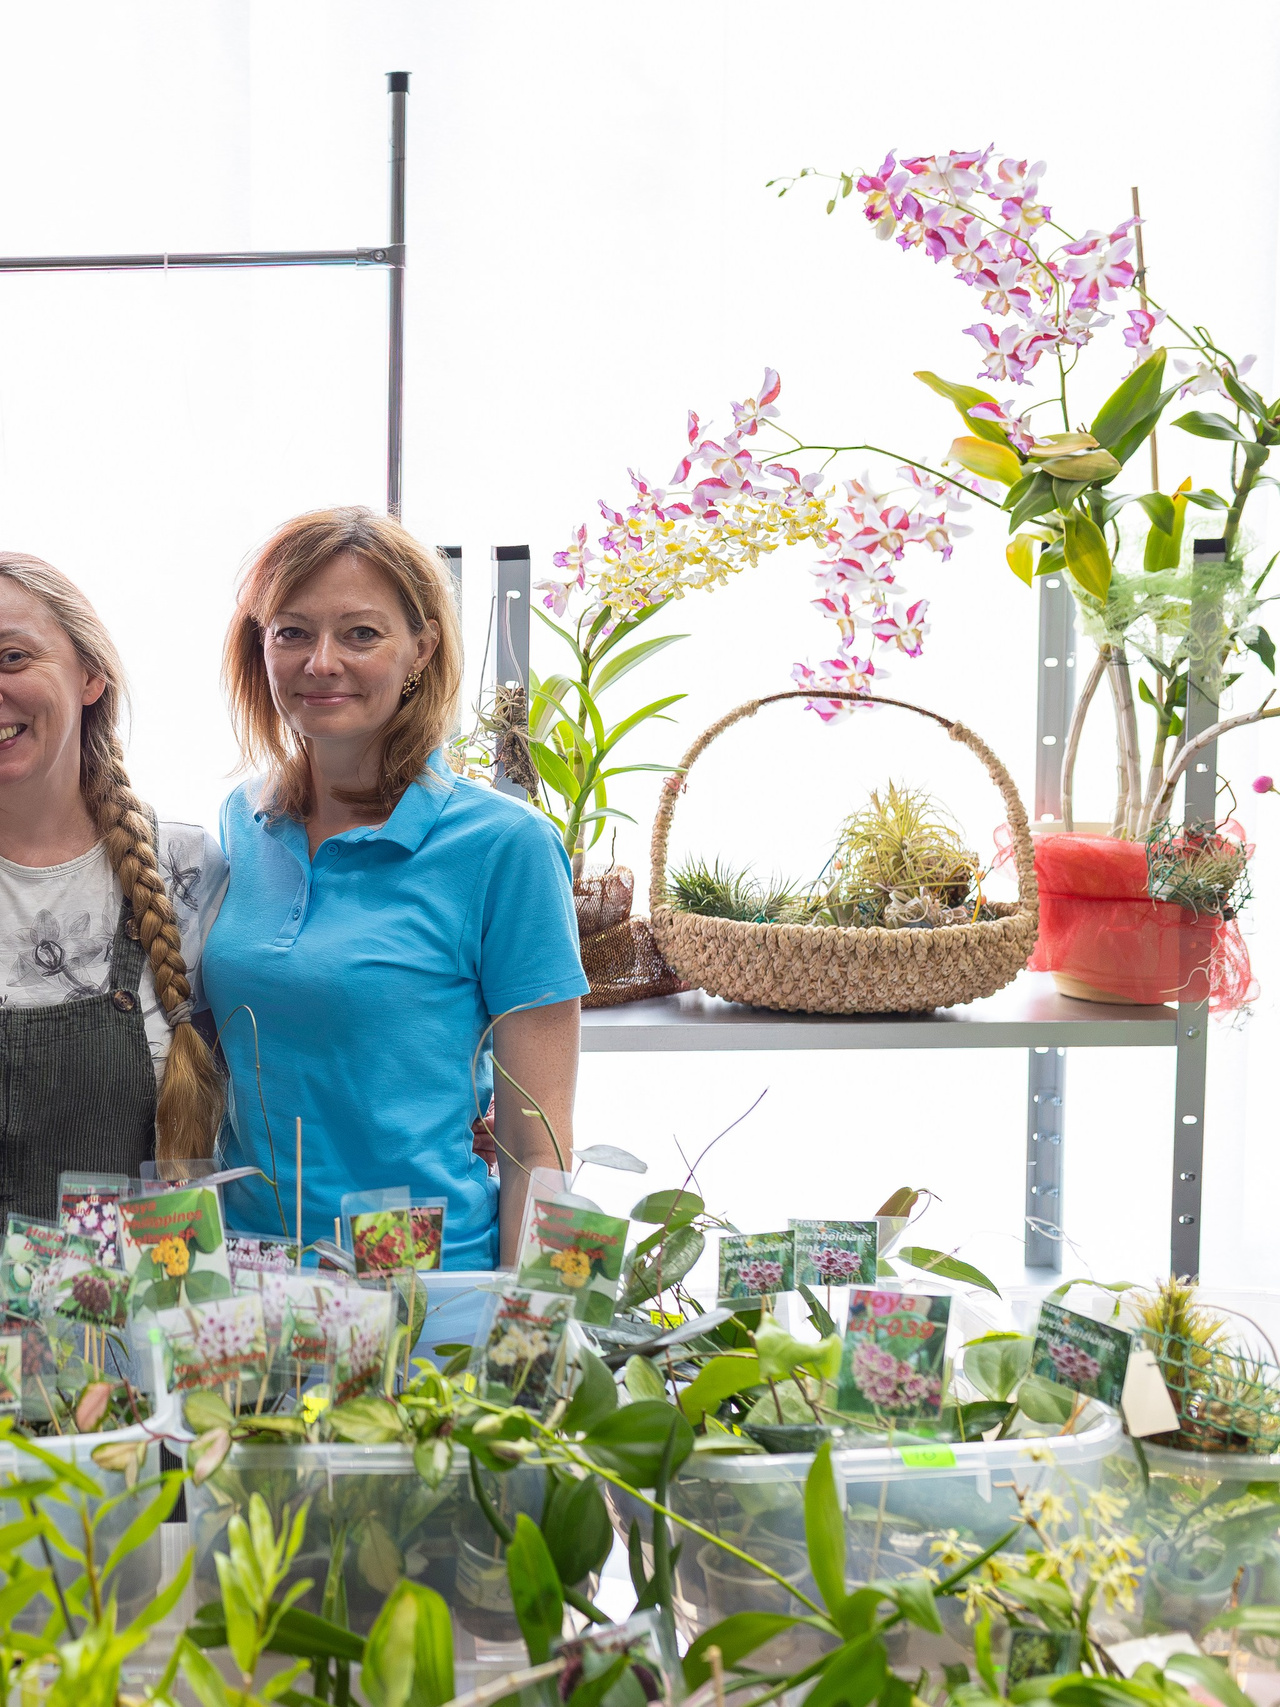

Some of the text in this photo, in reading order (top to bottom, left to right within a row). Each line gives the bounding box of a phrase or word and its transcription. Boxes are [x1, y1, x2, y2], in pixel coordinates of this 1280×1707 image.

[120, 1200, 157, 1219] Hoya
[123, 1209, 203, 1233] Philippines
[24, 1225, 64, 1244] Hoya
[853, 1290, 917, 1313] Hoya
[848, 1318, 936, 1340] ut-039
